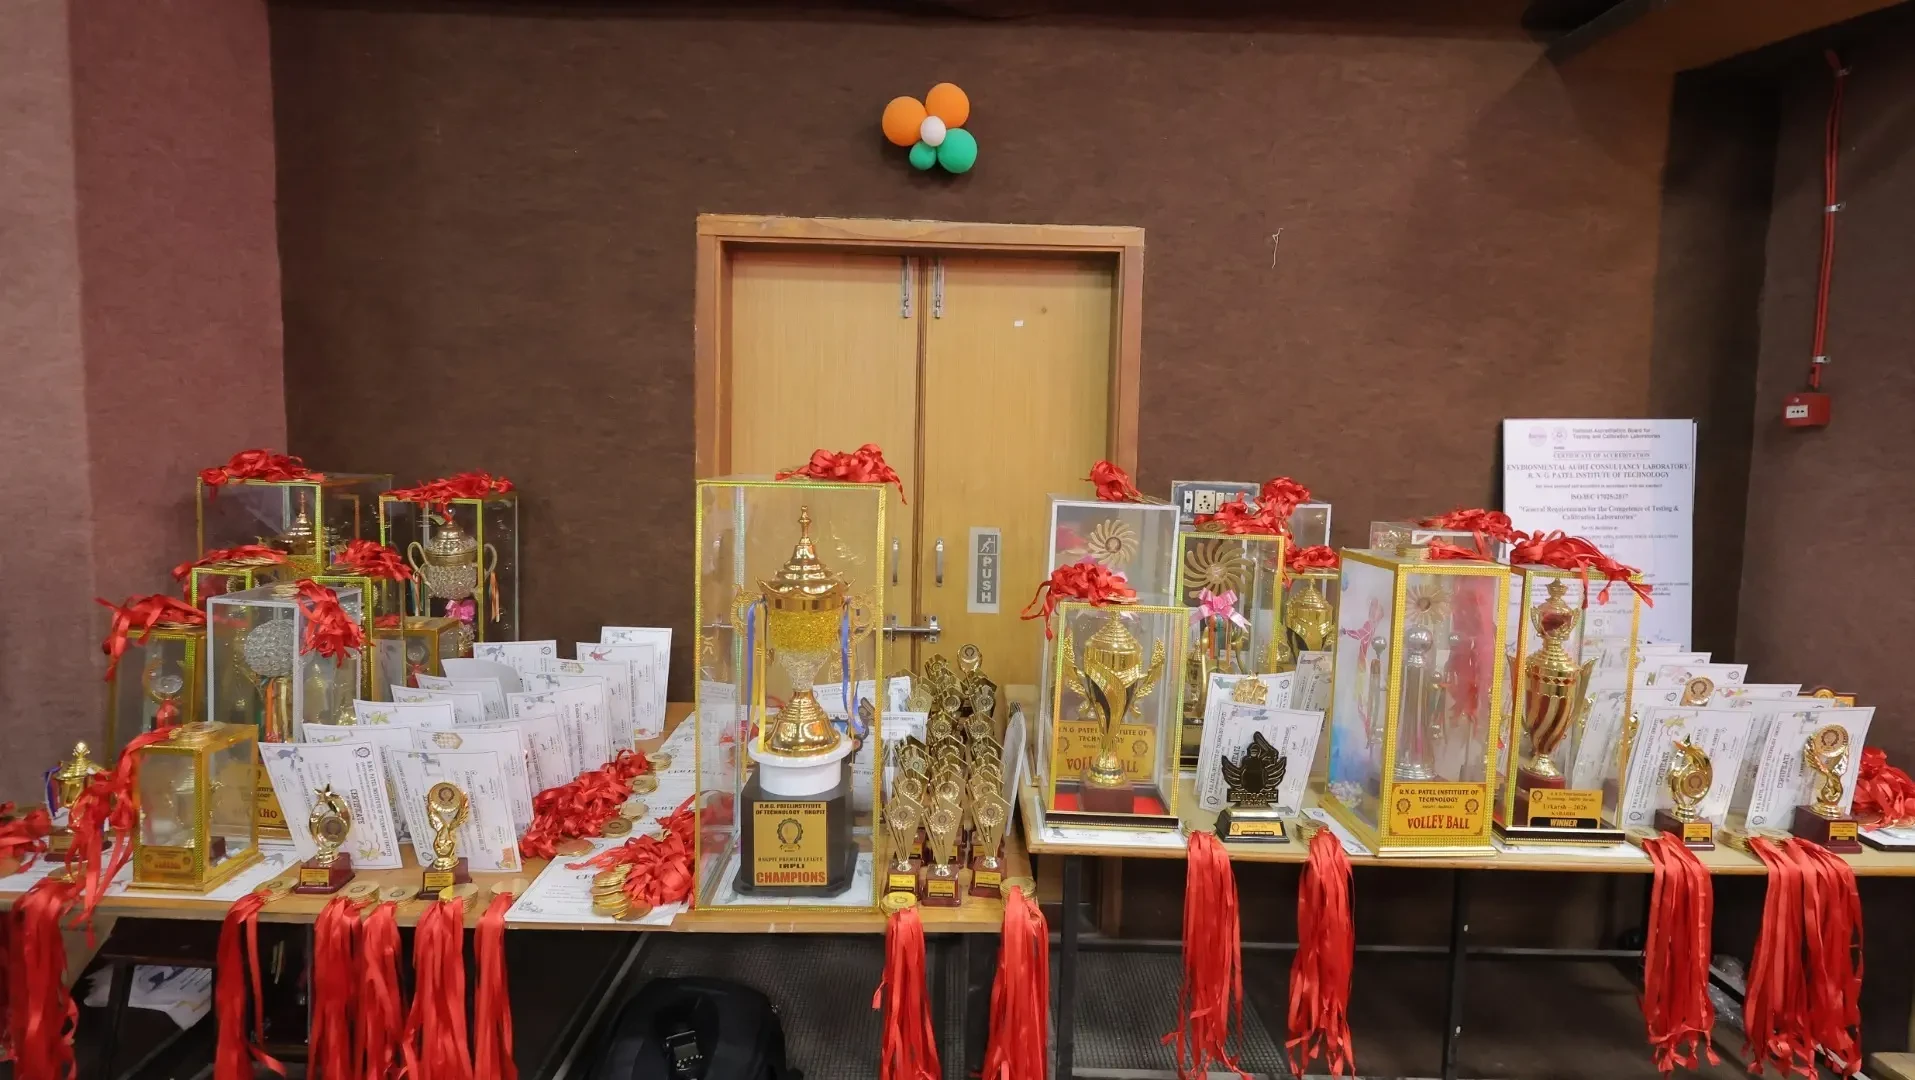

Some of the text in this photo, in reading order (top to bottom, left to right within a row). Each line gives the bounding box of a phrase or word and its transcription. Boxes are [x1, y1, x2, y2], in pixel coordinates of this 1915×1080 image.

[981, 556, 992, 602] PUSH
[1777, 752, 1791, 789] CERTIFICATE
[349, 788, 366, 826] CERTIFICATE
[1408, 815, 1469, 829] VOLLEY BALL
[1550, 819, 1578, 827] WINNER
[756, 872, 825, 883] CHAMPIONS
